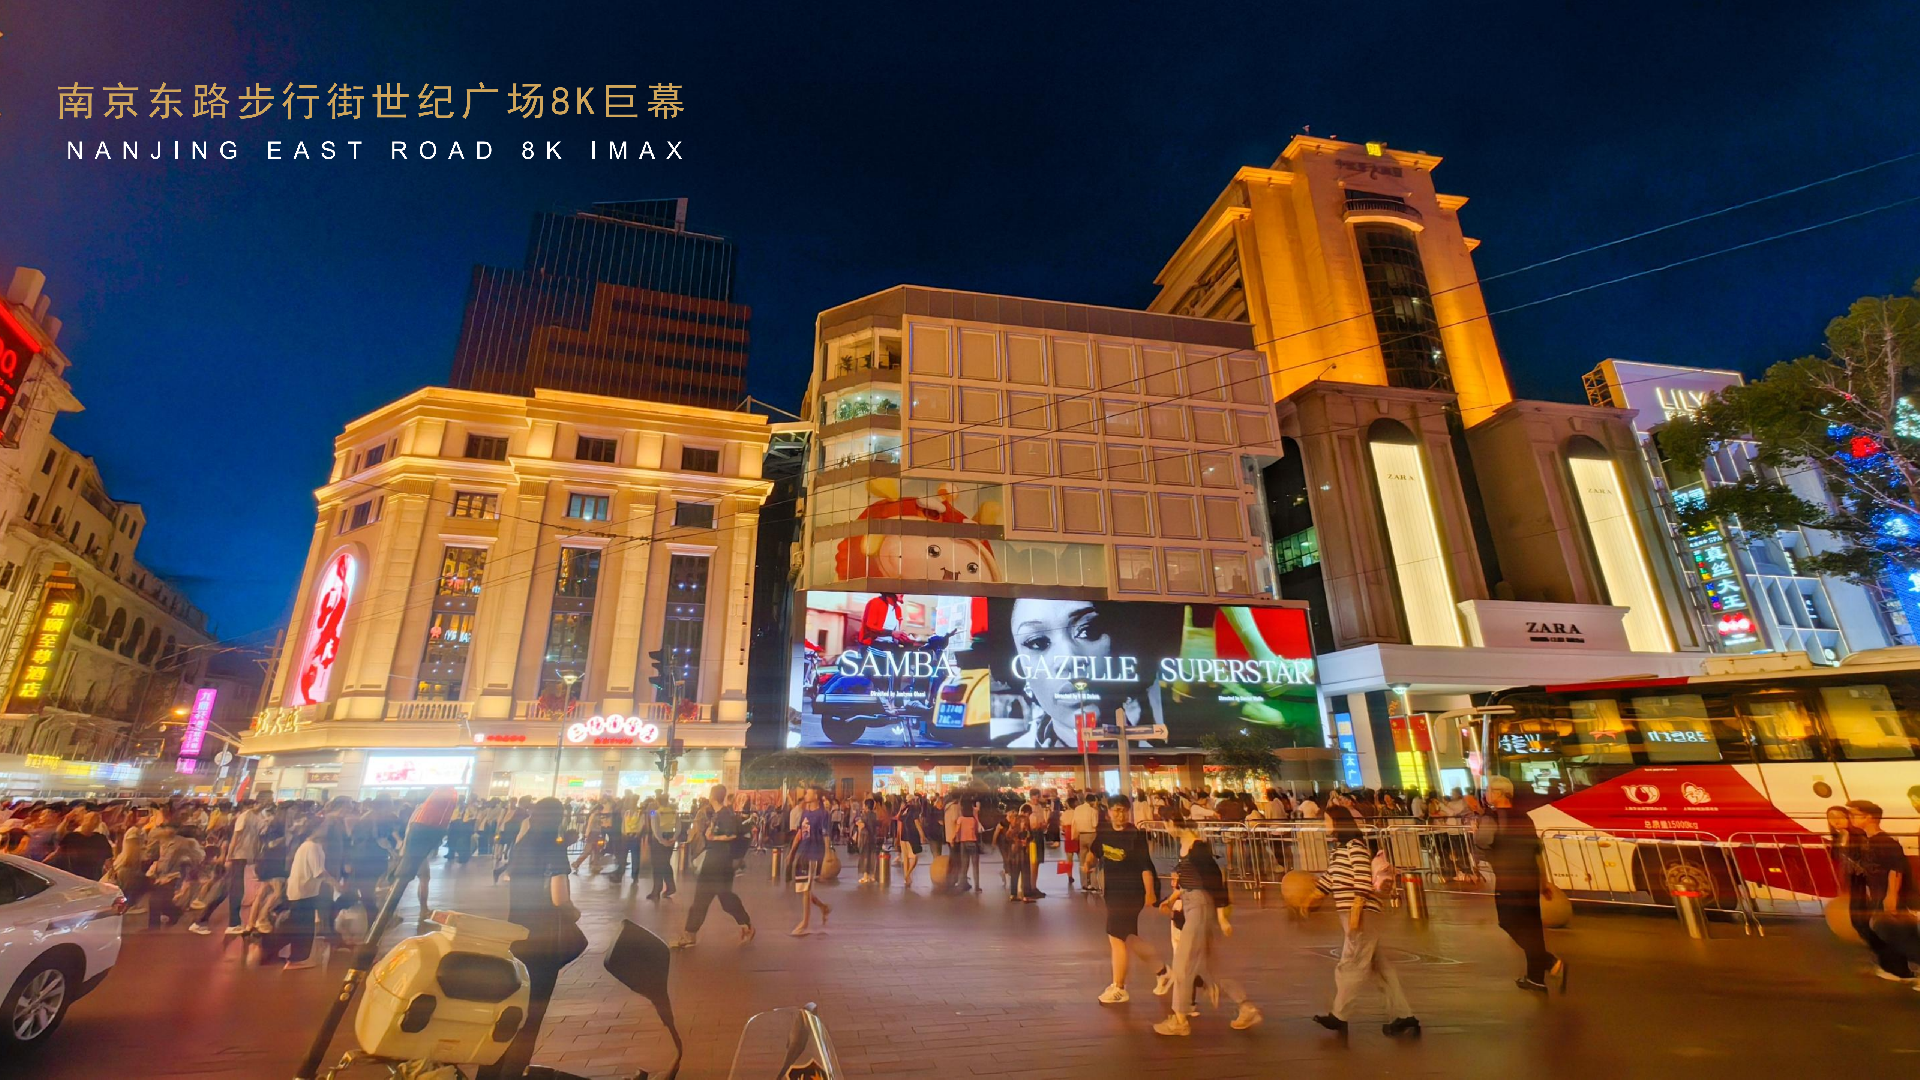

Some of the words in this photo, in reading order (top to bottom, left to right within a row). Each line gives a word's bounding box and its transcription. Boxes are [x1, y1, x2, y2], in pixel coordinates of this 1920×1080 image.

[1656, 387, 1706, 412] LILY
[1387, 473, 1414, 481] ZARA
[1587, 487, 1613, 495] ZARA
[1525, 621, 1582, 635] ZARA
[18, 602, 70, 698] 和颐至尊酒店
[840, 650, 957, 679] SAMBA
[1011, 654, 1139, 682] GAZELLE
[1160, 657, 1315, 685] SUPERSTAR
